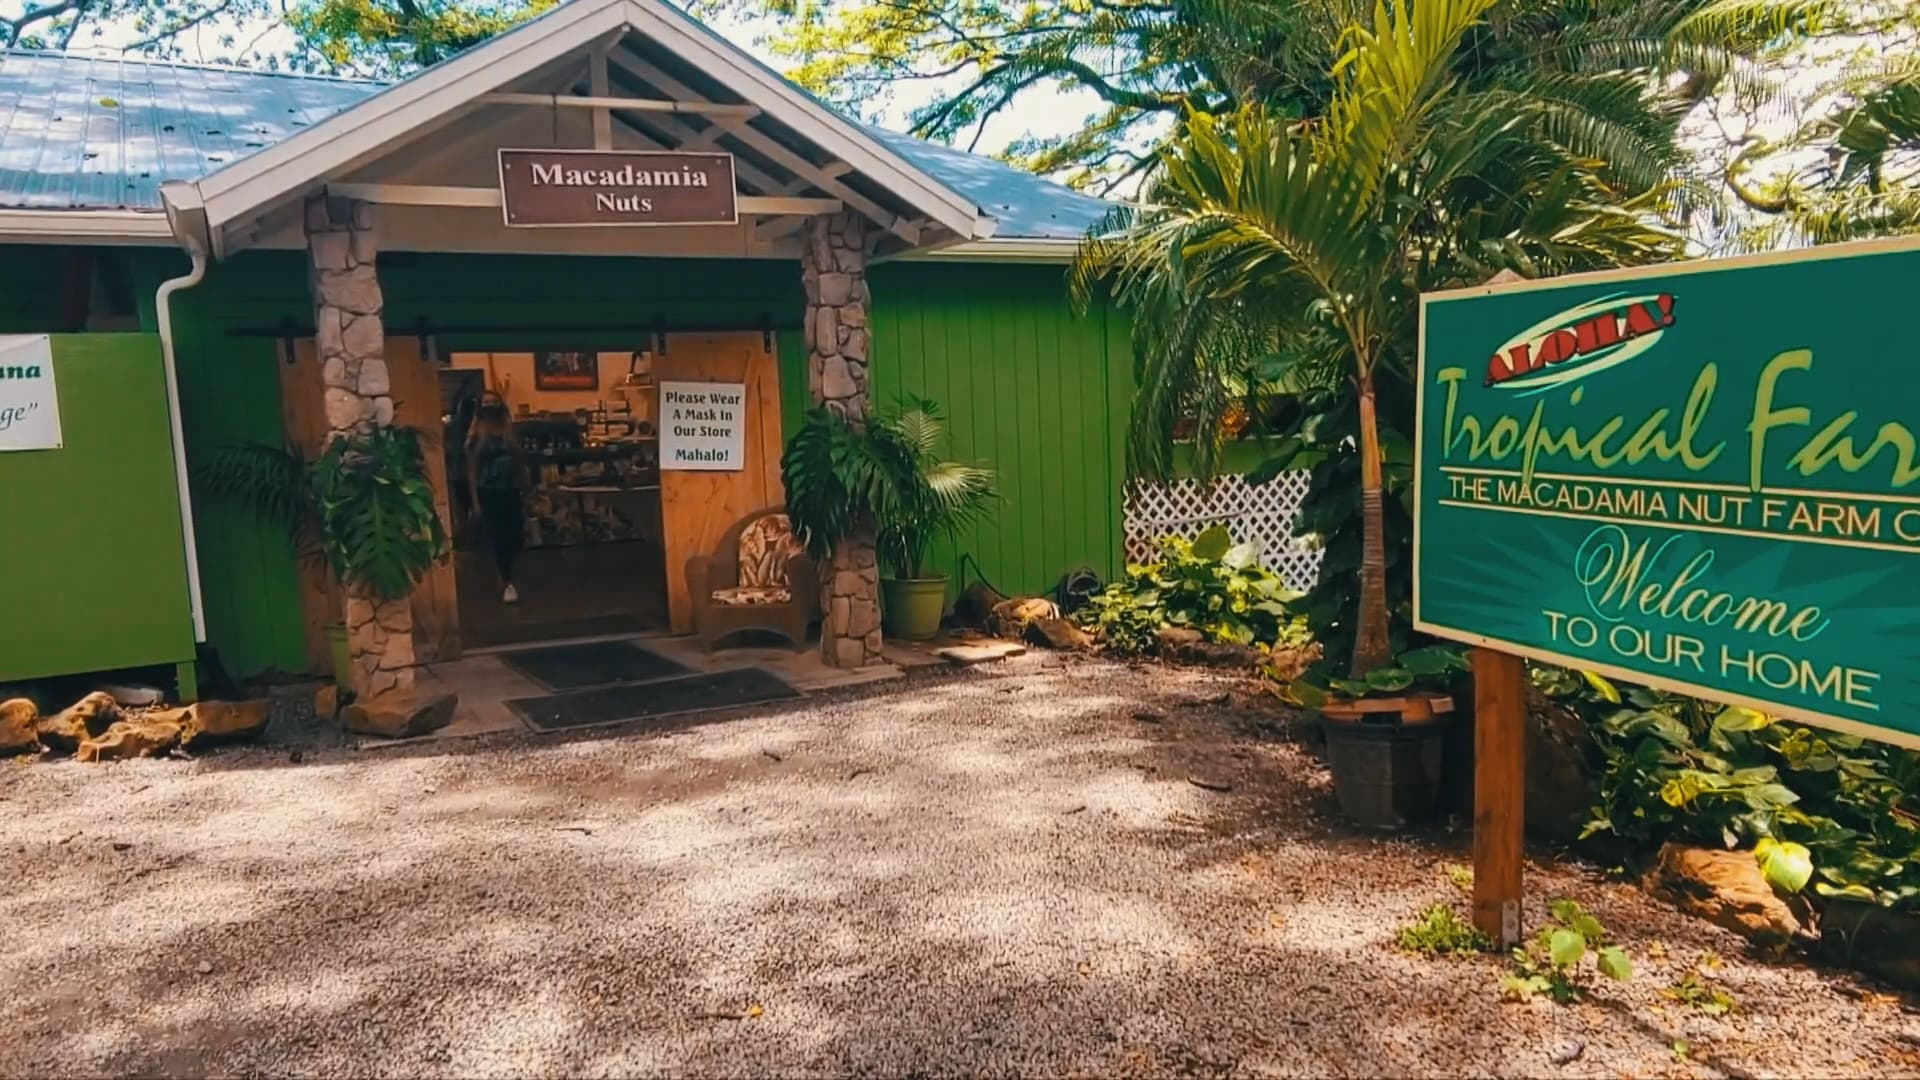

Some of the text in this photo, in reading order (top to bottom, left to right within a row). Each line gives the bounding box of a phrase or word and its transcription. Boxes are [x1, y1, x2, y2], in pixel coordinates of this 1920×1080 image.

[531, 163, 708, 187] Macadamia
[596, 193, 652, 212] Nuts
[1484, 293, 1677, 387] ALOHA!
[666, 392, 741, 405] Please Wear
[672, 409, 733, 421] A Mask In
[1437, 362, 1727, 484] Tropical
[673, 425, 731, 437] Our Store
[675, 448, 729, 461] Mahalo!
[1448, 476, 1492, 501] THE
[1498, 479, 1669, 519] MACADAMIA
[1678, 493, 1752, 527] NUT
[1762, 500, 1880, 538] FARM
[1575, 524, 1831, 642] Welcome
[1542, 609, 1881, 711] TO OUR HOME
